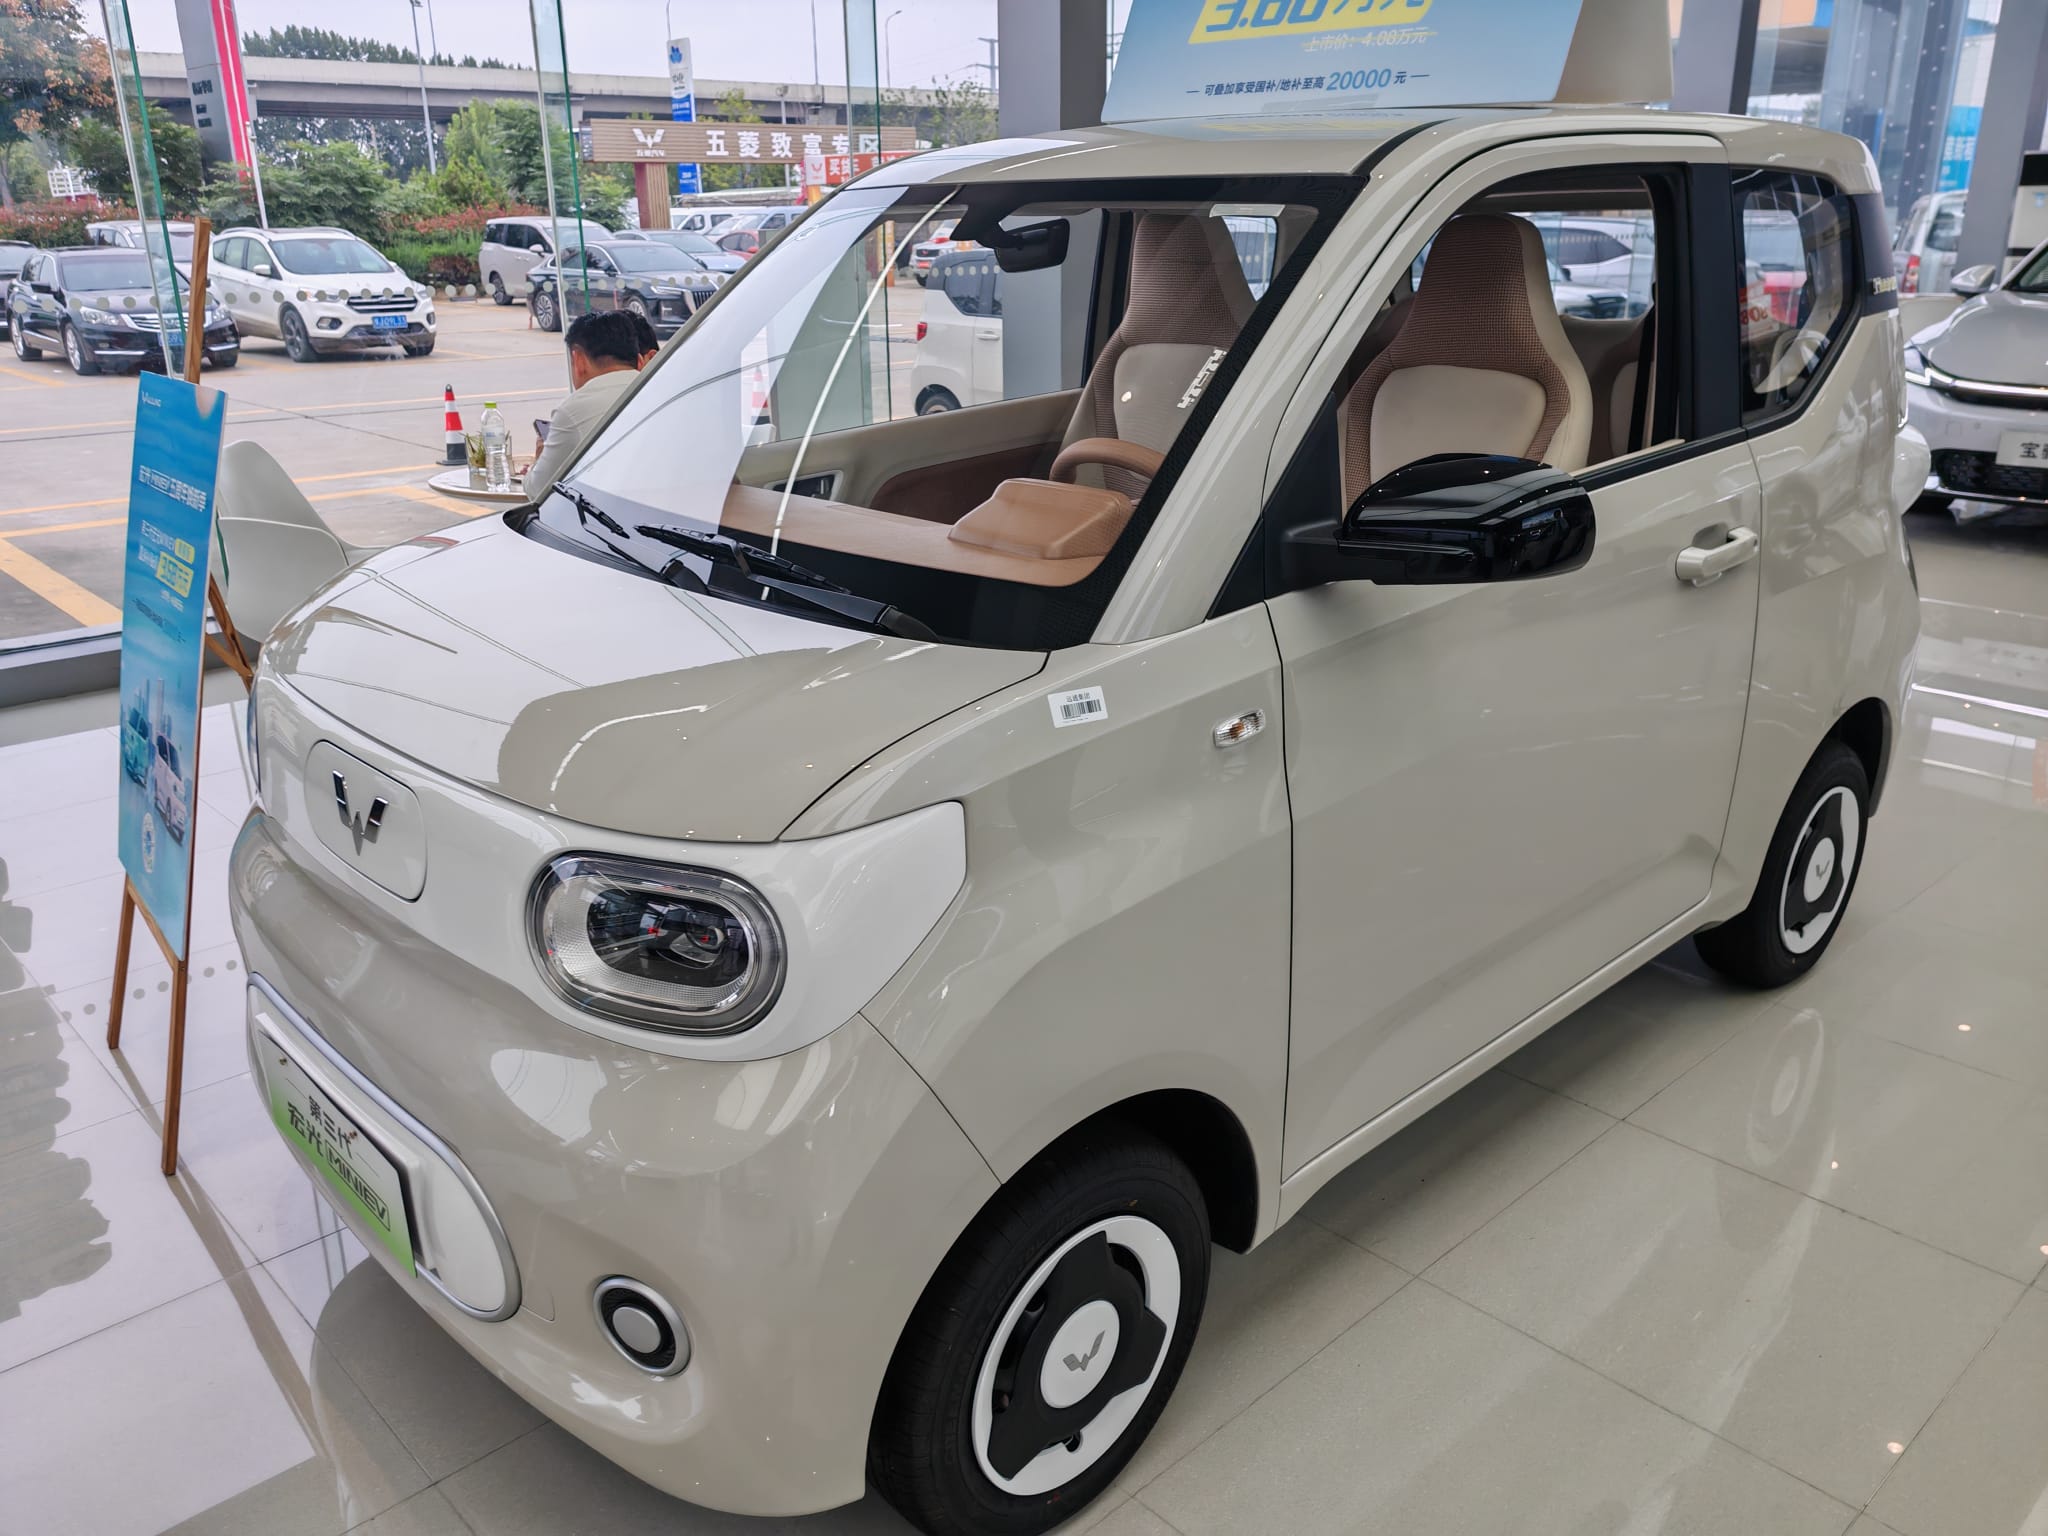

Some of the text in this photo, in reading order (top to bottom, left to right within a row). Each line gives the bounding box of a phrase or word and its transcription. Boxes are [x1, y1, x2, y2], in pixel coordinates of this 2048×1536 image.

[1326, 68, 1392, 91] 20000
[1393, 71, 1407, 85] 元
[705, 128, 882, 158] 五菱致富专区
[2019, 442, 2048, 460] 宝
[309, 1097, 353, 1159] 第三代
[328, 1152, 387, 1221] MINIEV
